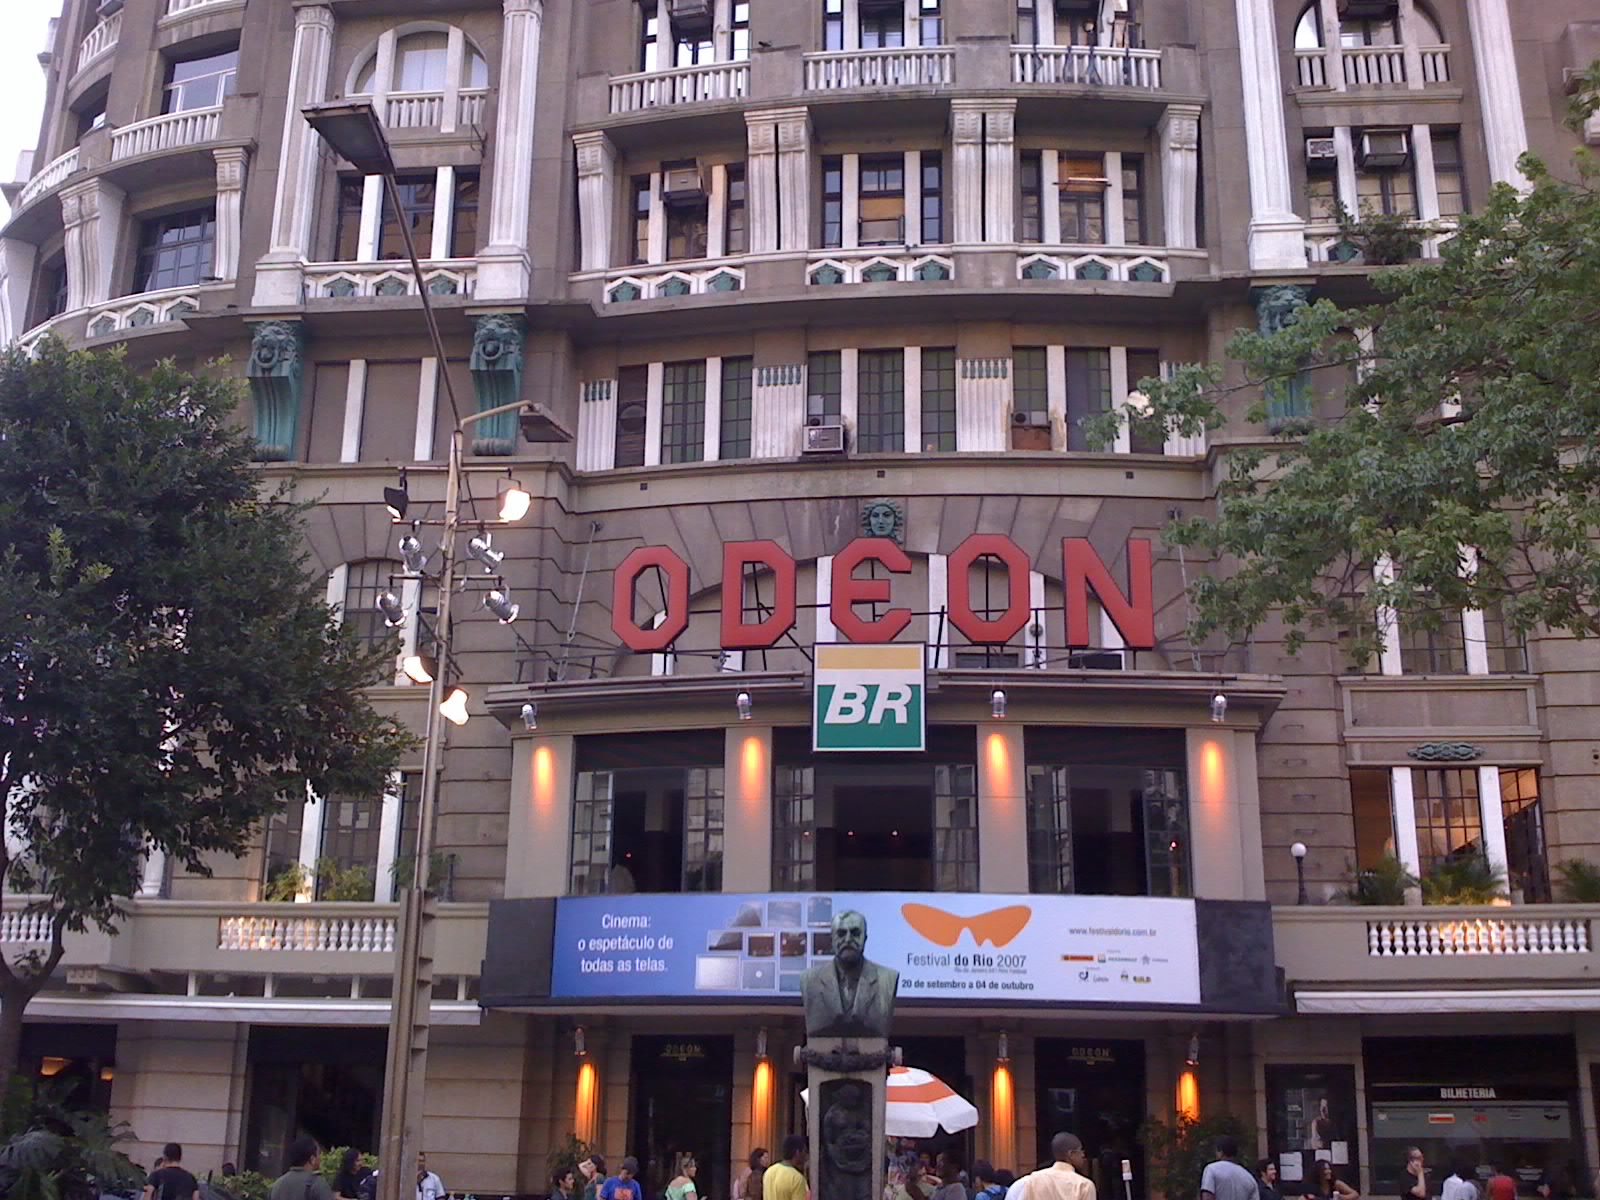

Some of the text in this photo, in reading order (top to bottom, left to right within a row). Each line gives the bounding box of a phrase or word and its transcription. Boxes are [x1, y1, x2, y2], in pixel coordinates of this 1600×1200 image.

[611, 533, 1156, 652] ODEON
[823, 682, 913, 724] BR
[602, 913, 651, 929] Cinema:
[578, 935, 673, 953] o espetáculo de
[581, 957, 668, 973] todas as telas.
[907, 953, 1026, 968] Festival do Rio 2007
[901, 979, 1034, 991] 20 de setembro a 04 de outubro
[1440, 1087, 1497, 1099] BILHETERIA
